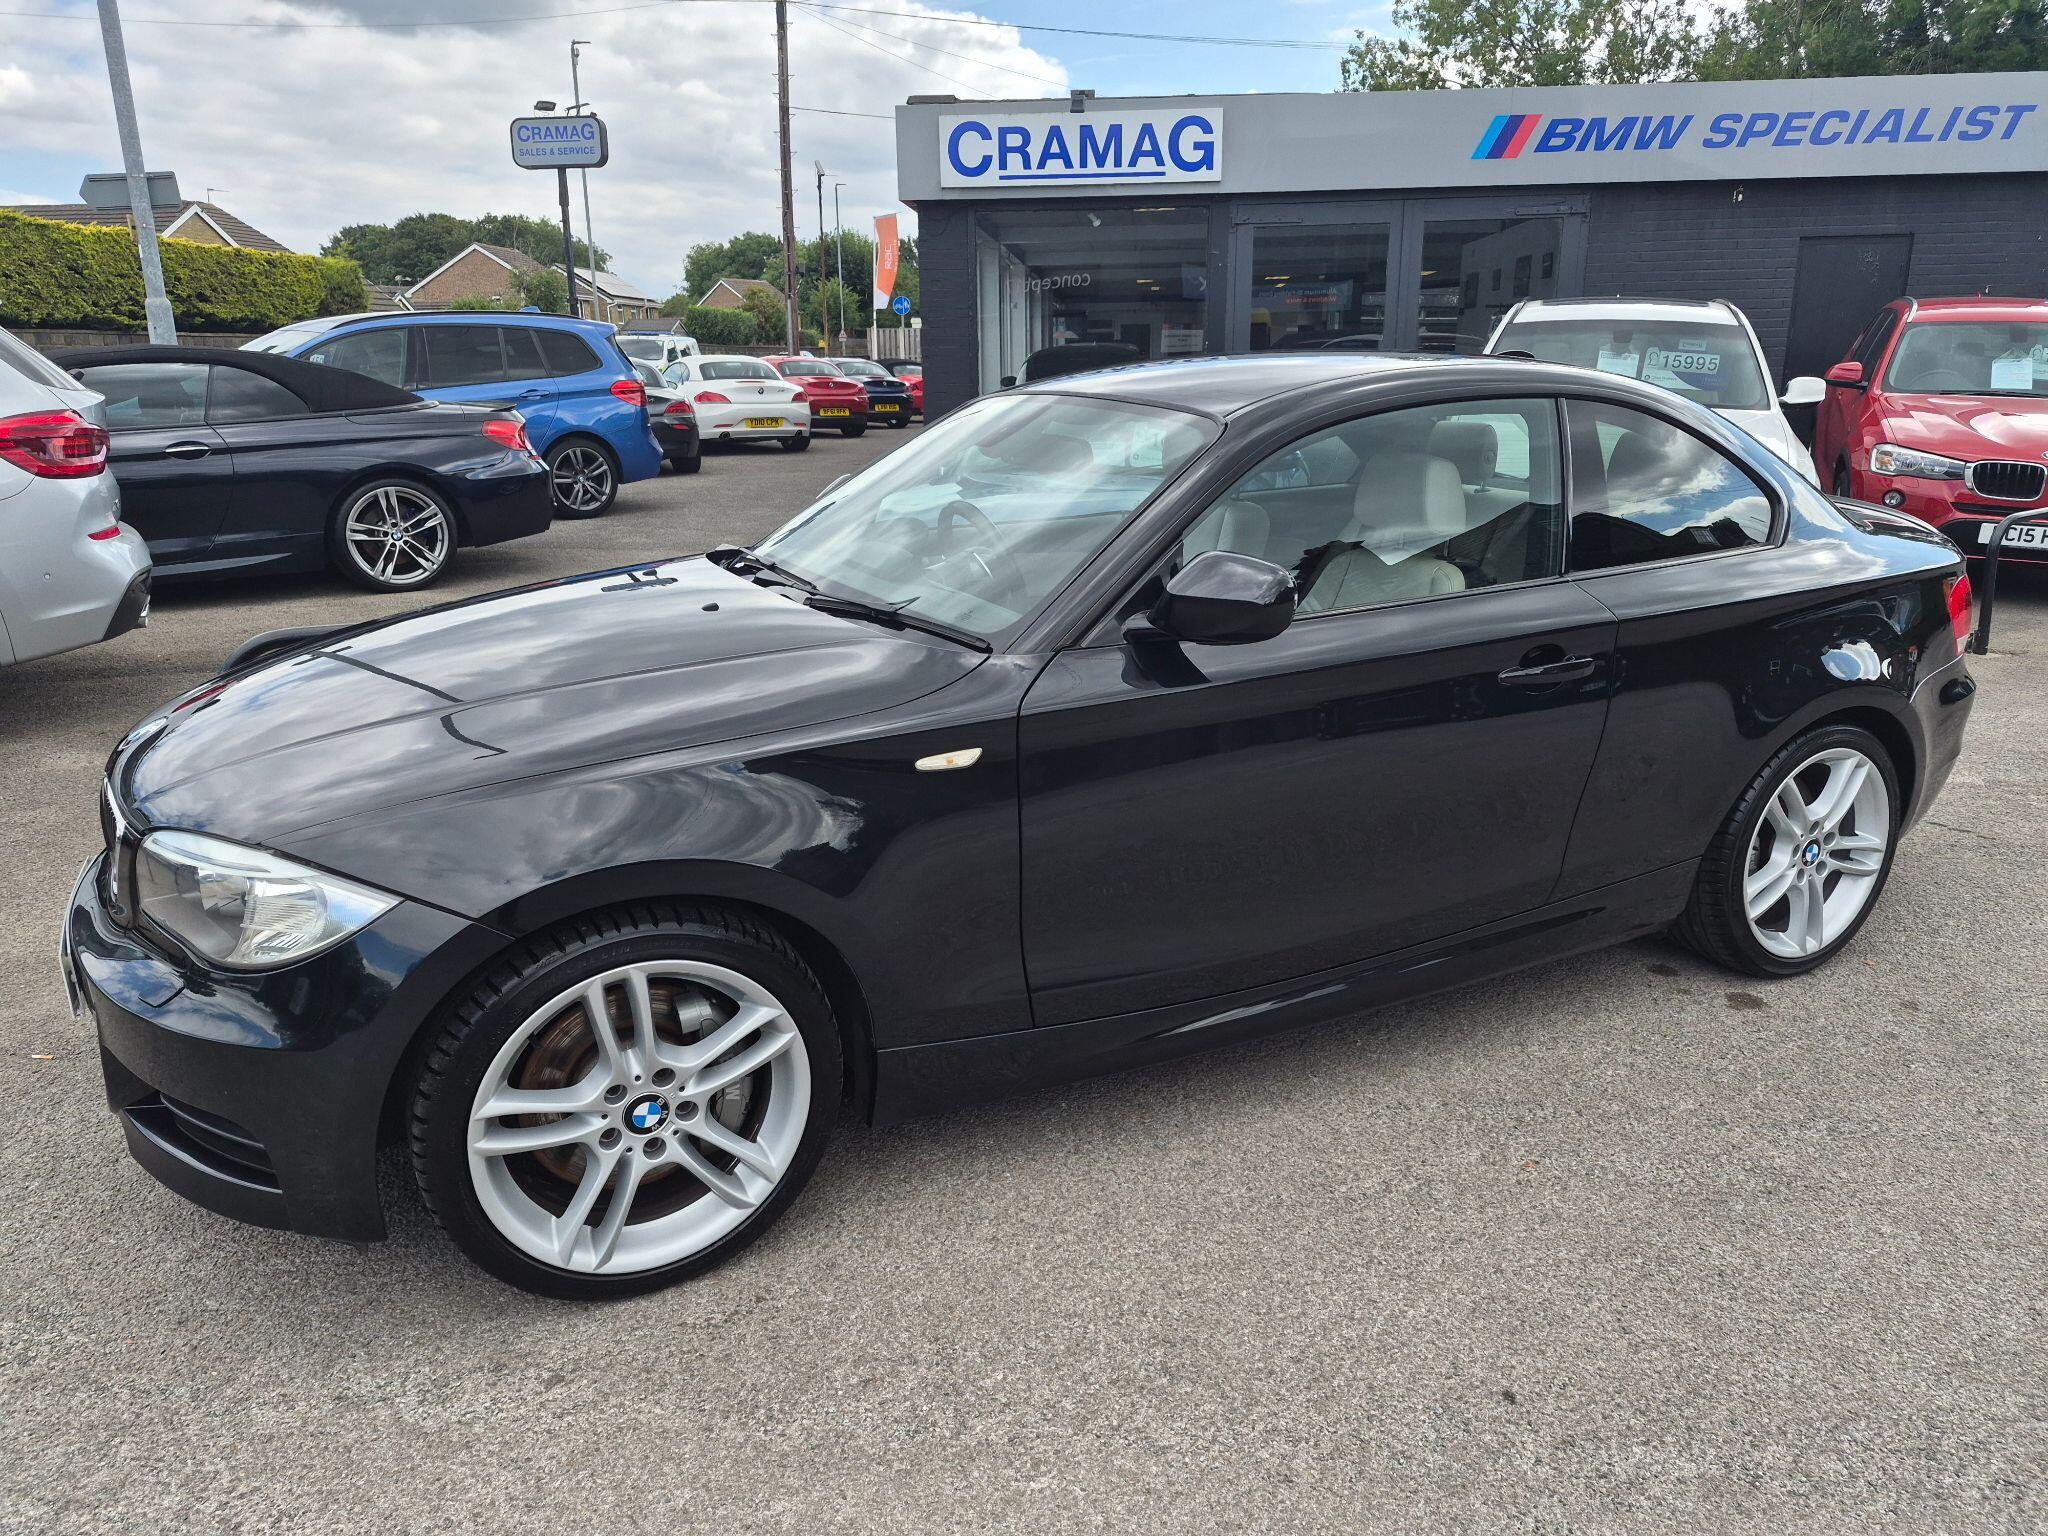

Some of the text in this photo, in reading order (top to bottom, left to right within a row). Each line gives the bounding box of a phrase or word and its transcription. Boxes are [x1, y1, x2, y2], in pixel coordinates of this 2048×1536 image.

[517, 122, 595, 142] CRAMAG
[1533, 104, 2038, 153] BMW SPECIALIST
[519, 146, 596, 157] SALES & SERVICE
[947, 115, 1215, 178] CRAMAG
[1993, 526, 2036, 543] C15
